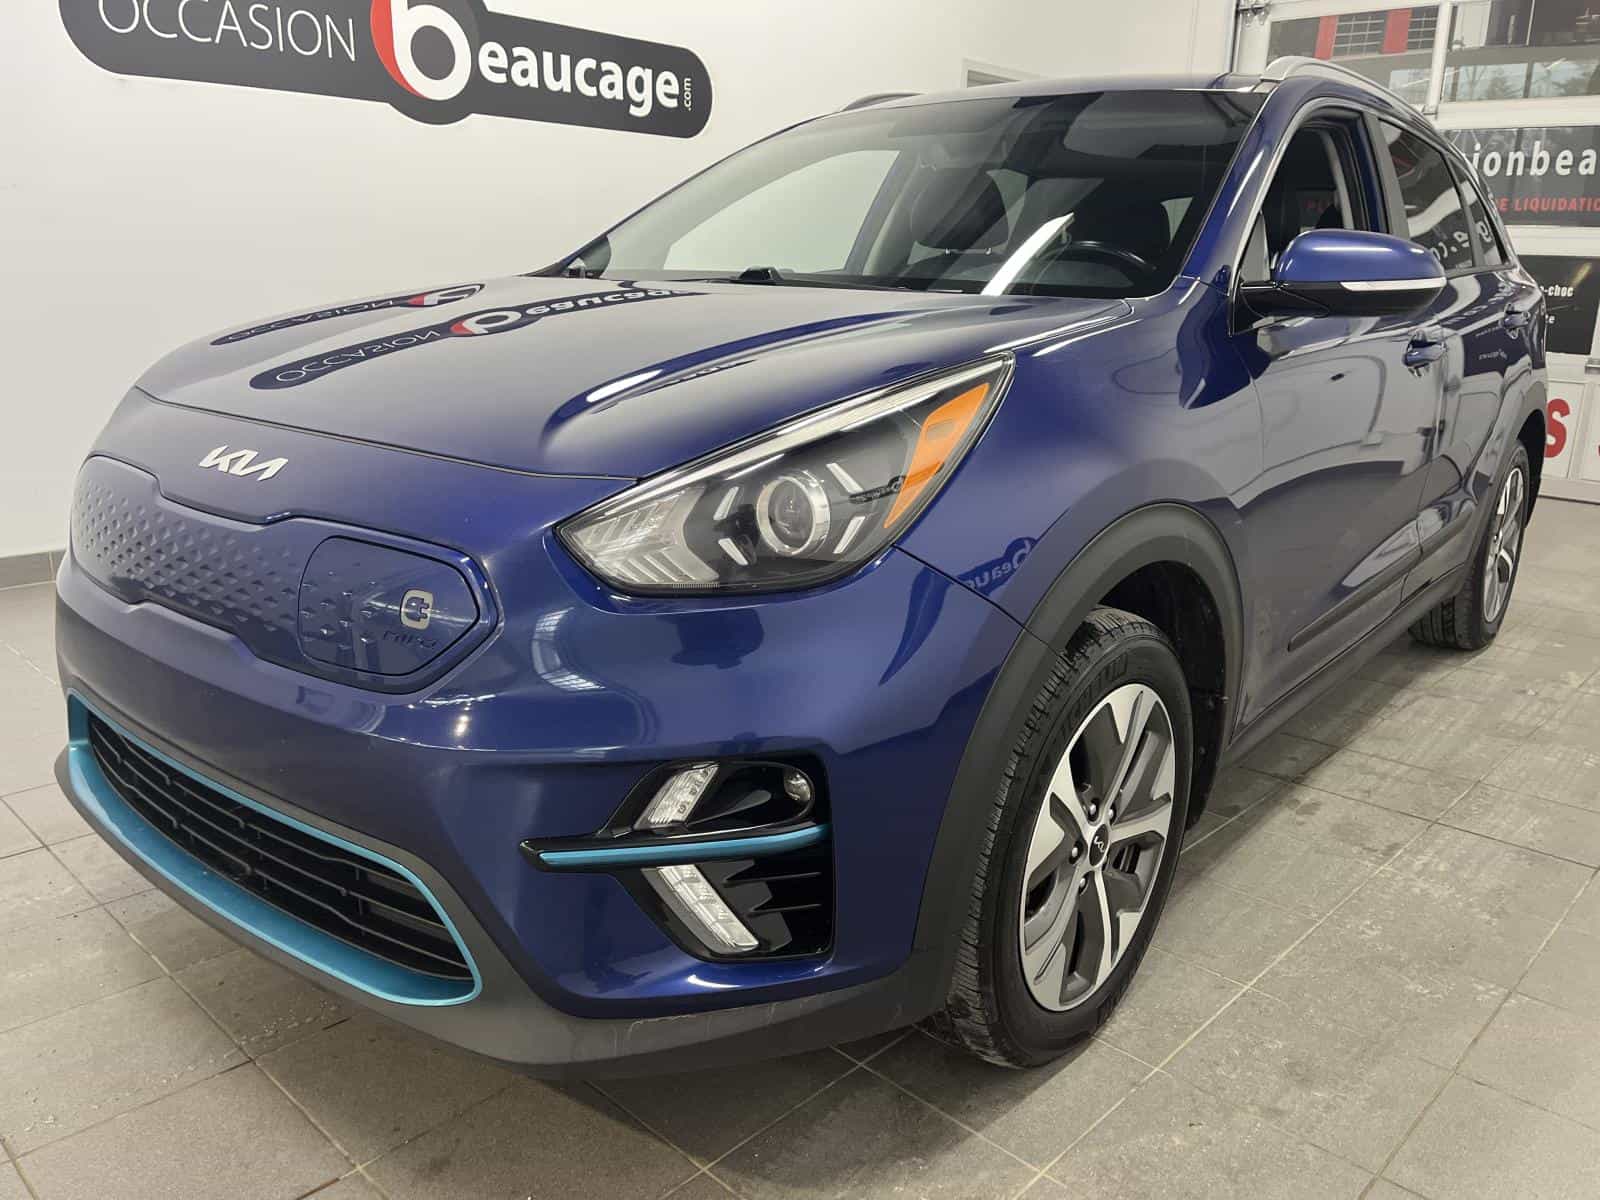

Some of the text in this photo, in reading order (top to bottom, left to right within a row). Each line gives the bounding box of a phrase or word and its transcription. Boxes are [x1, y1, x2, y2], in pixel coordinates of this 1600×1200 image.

[99, 0, 355, 61] OCCASION
[683, 77, 692, 111] .com
[1472, 140, 1598, 177] ionbea
[1544, 398, 1570, 458] S
[199, 445, 289, 481] KIA
